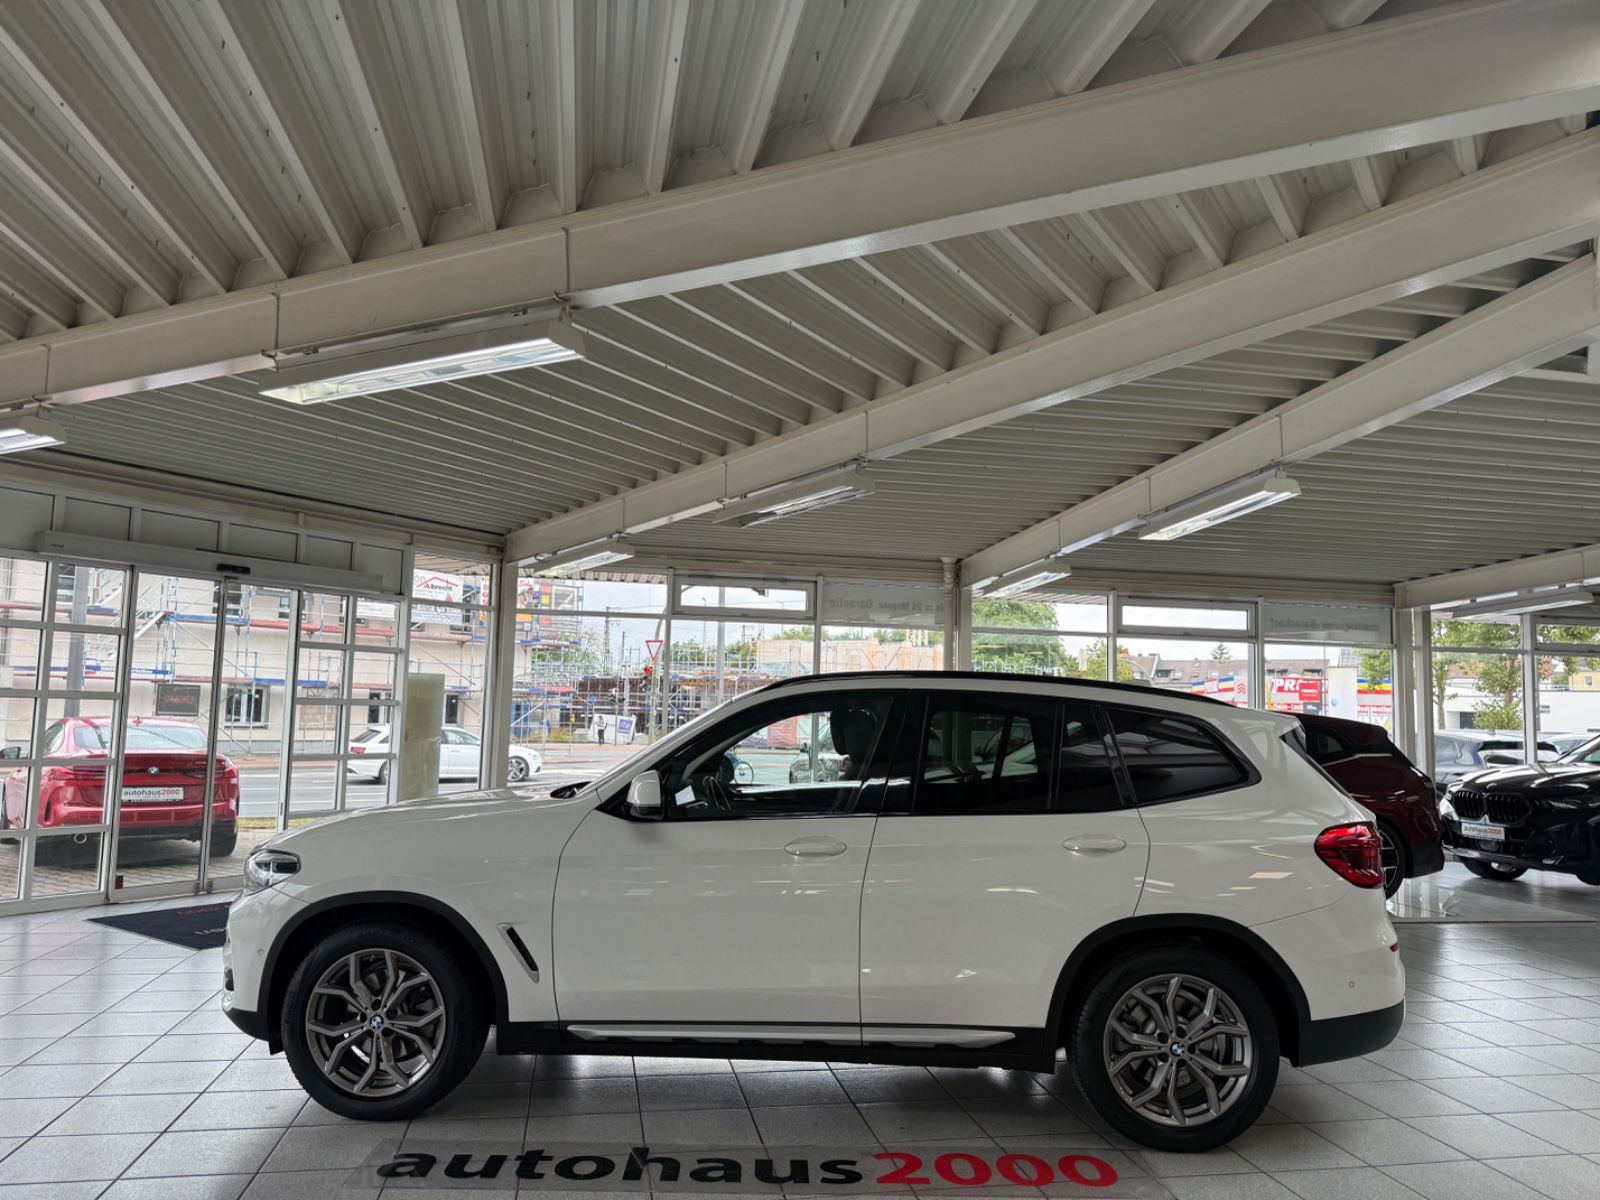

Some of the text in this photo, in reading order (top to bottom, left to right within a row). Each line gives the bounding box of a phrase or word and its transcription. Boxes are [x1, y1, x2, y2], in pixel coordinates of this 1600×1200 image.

[424, 583, 453, 592] Albrecht
[123, 788, 180, 797] autohaus2000
[376, 1147, 1119, 1187] autohaus2000
